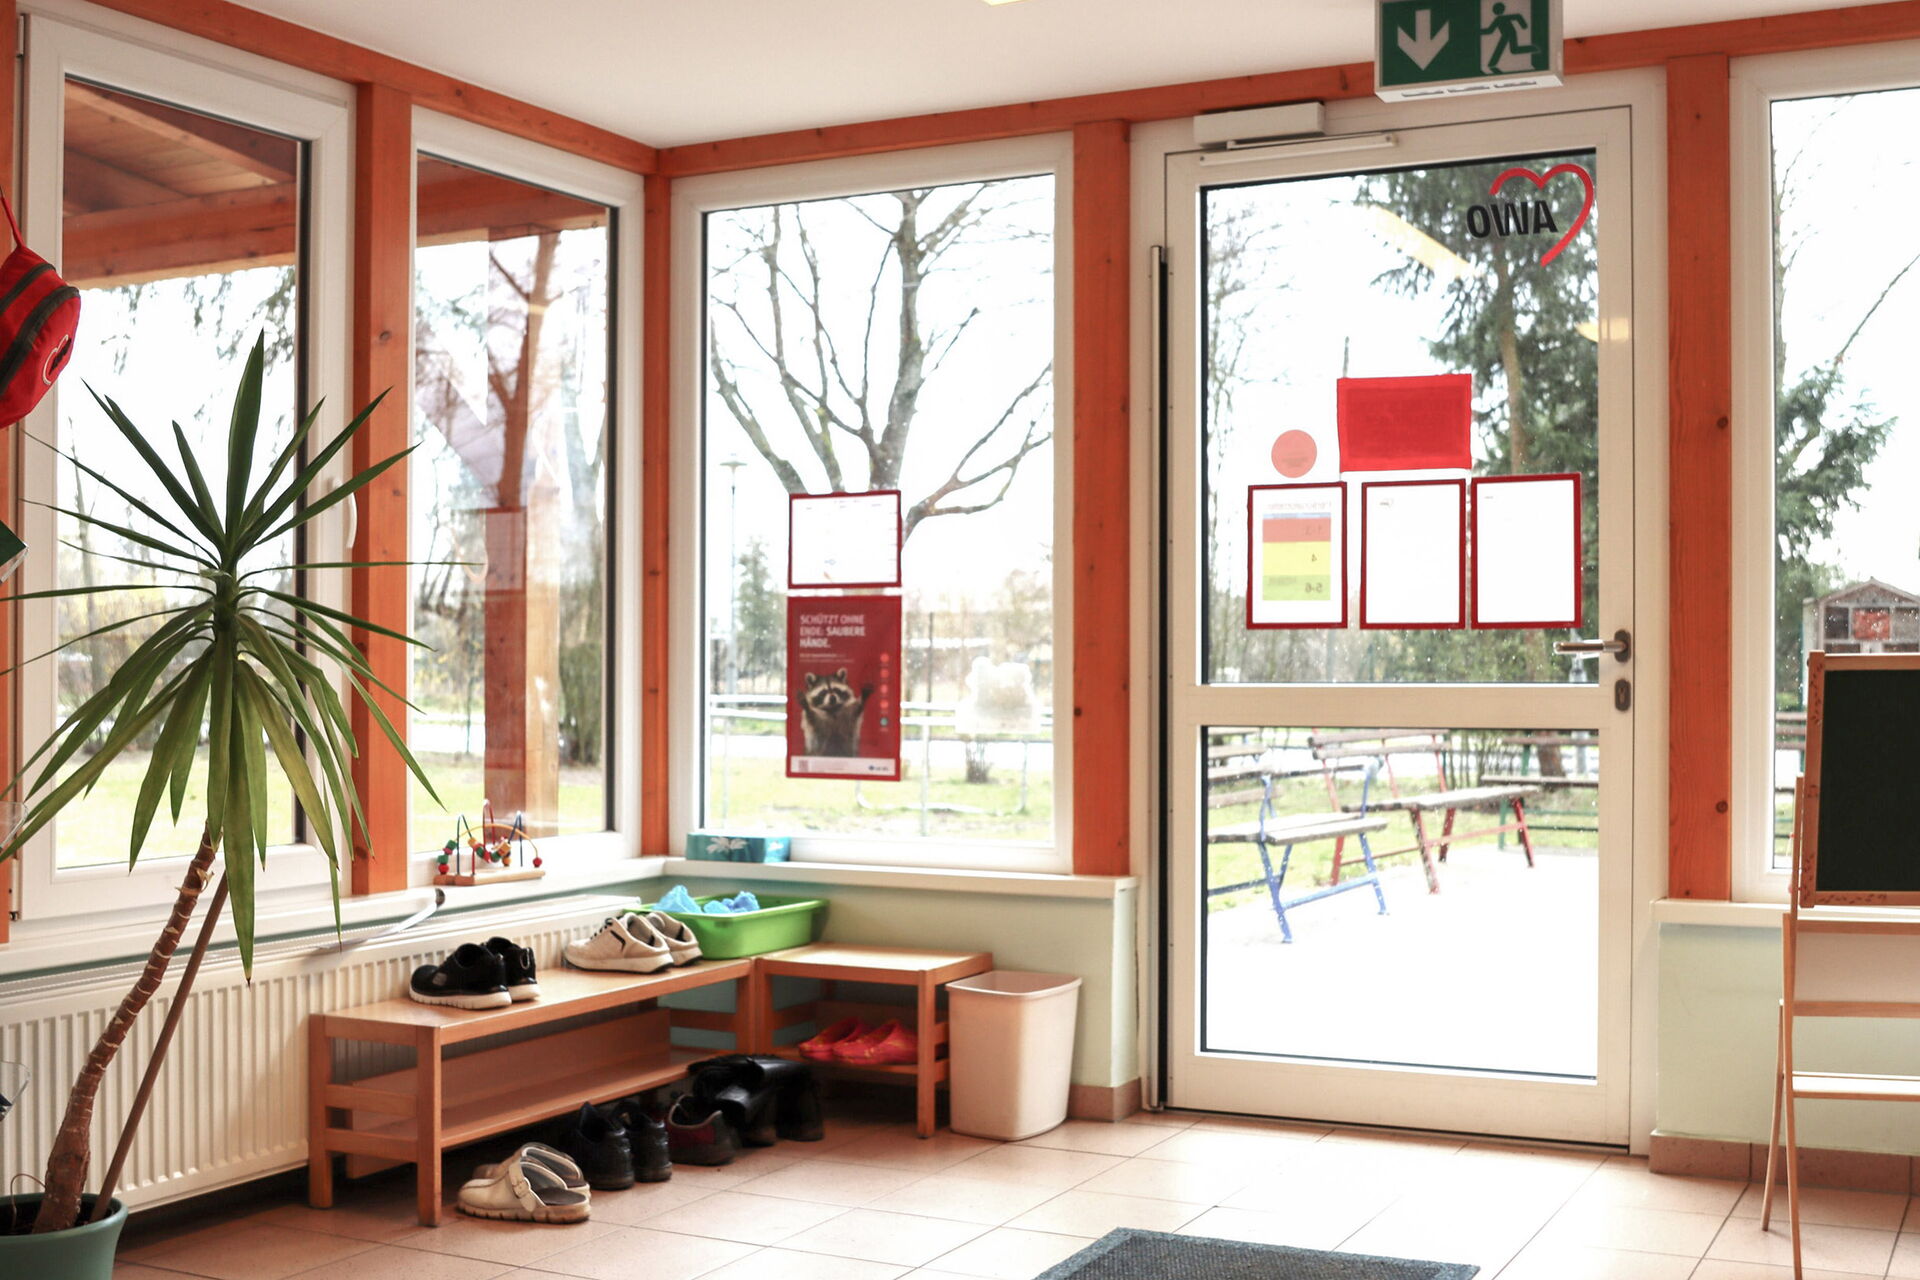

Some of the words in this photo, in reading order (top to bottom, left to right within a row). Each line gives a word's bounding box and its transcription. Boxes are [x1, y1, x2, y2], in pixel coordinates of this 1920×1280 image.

[800, 612, 839, 624] SCHÜTZT
[840, 614, 864, 624] OHNE
[826, 626, 865, 636] SAUBERE
